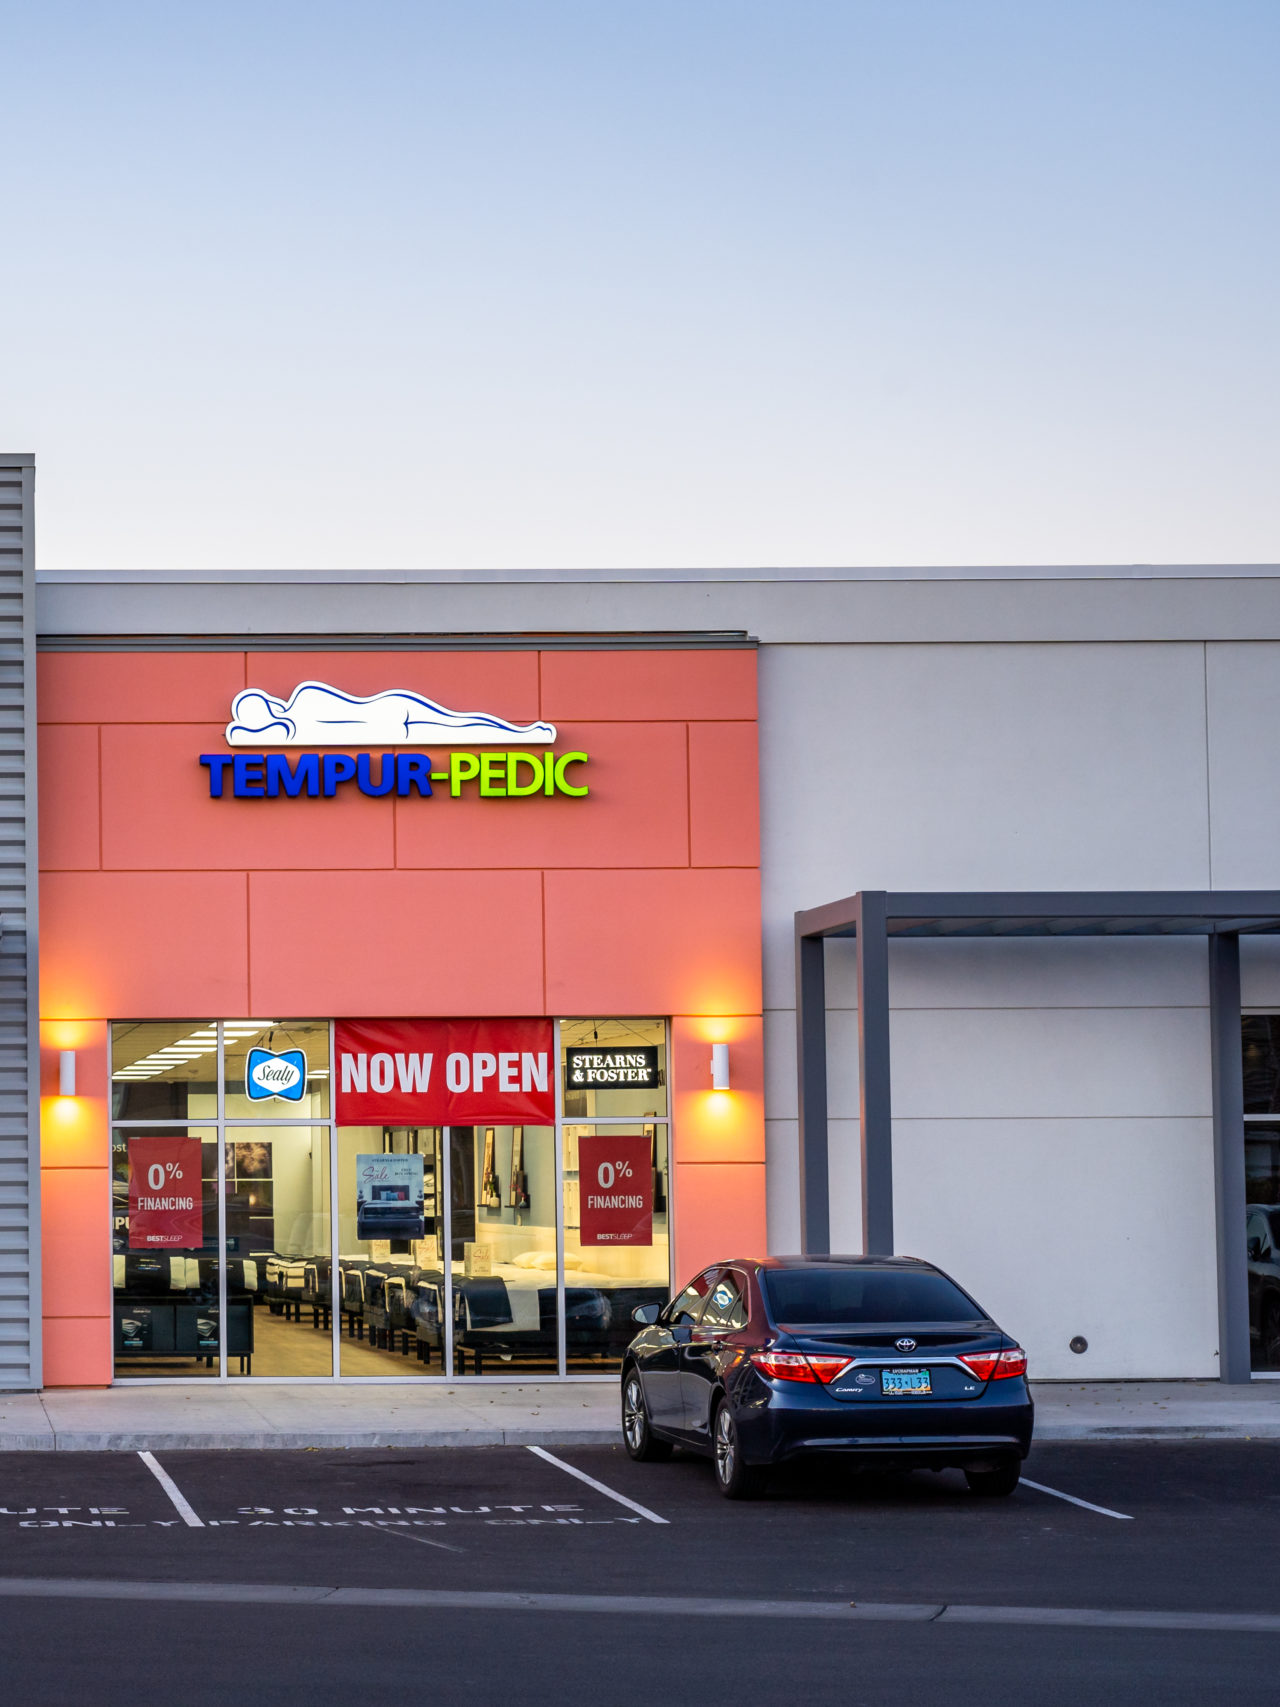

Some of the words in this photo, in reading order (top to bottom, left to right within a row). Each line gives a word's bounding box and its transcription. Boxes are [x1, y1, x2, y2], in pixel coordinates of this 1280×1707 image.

[199, 751, 589, 798] TEMPUR-PEDIC
[572, 1054, 646, 1068] STEARNS
[257, 1064, 295, 1085] Sealy
[341, 1052, 434, 1094] NOW
[446, 1052, 549, 1093] OPEN
[572, 1069, 584, 1082] &
[586, 1069, 650, 1082] FOSTER
[148, 1162, 183, 1190] 0%
[597, 1161, 633, 1189] 0%
[137, 1197, 193, 1210] FINANCING
[587, 1195, 643, 1208] FINANCING
[237, 1507, 319, 1515] 30
[342, 1504, 585, 1515] MINUTE
[18, 1520, 180, 1528] ONLY
[484, 1517, 645, 1525] ONLY
